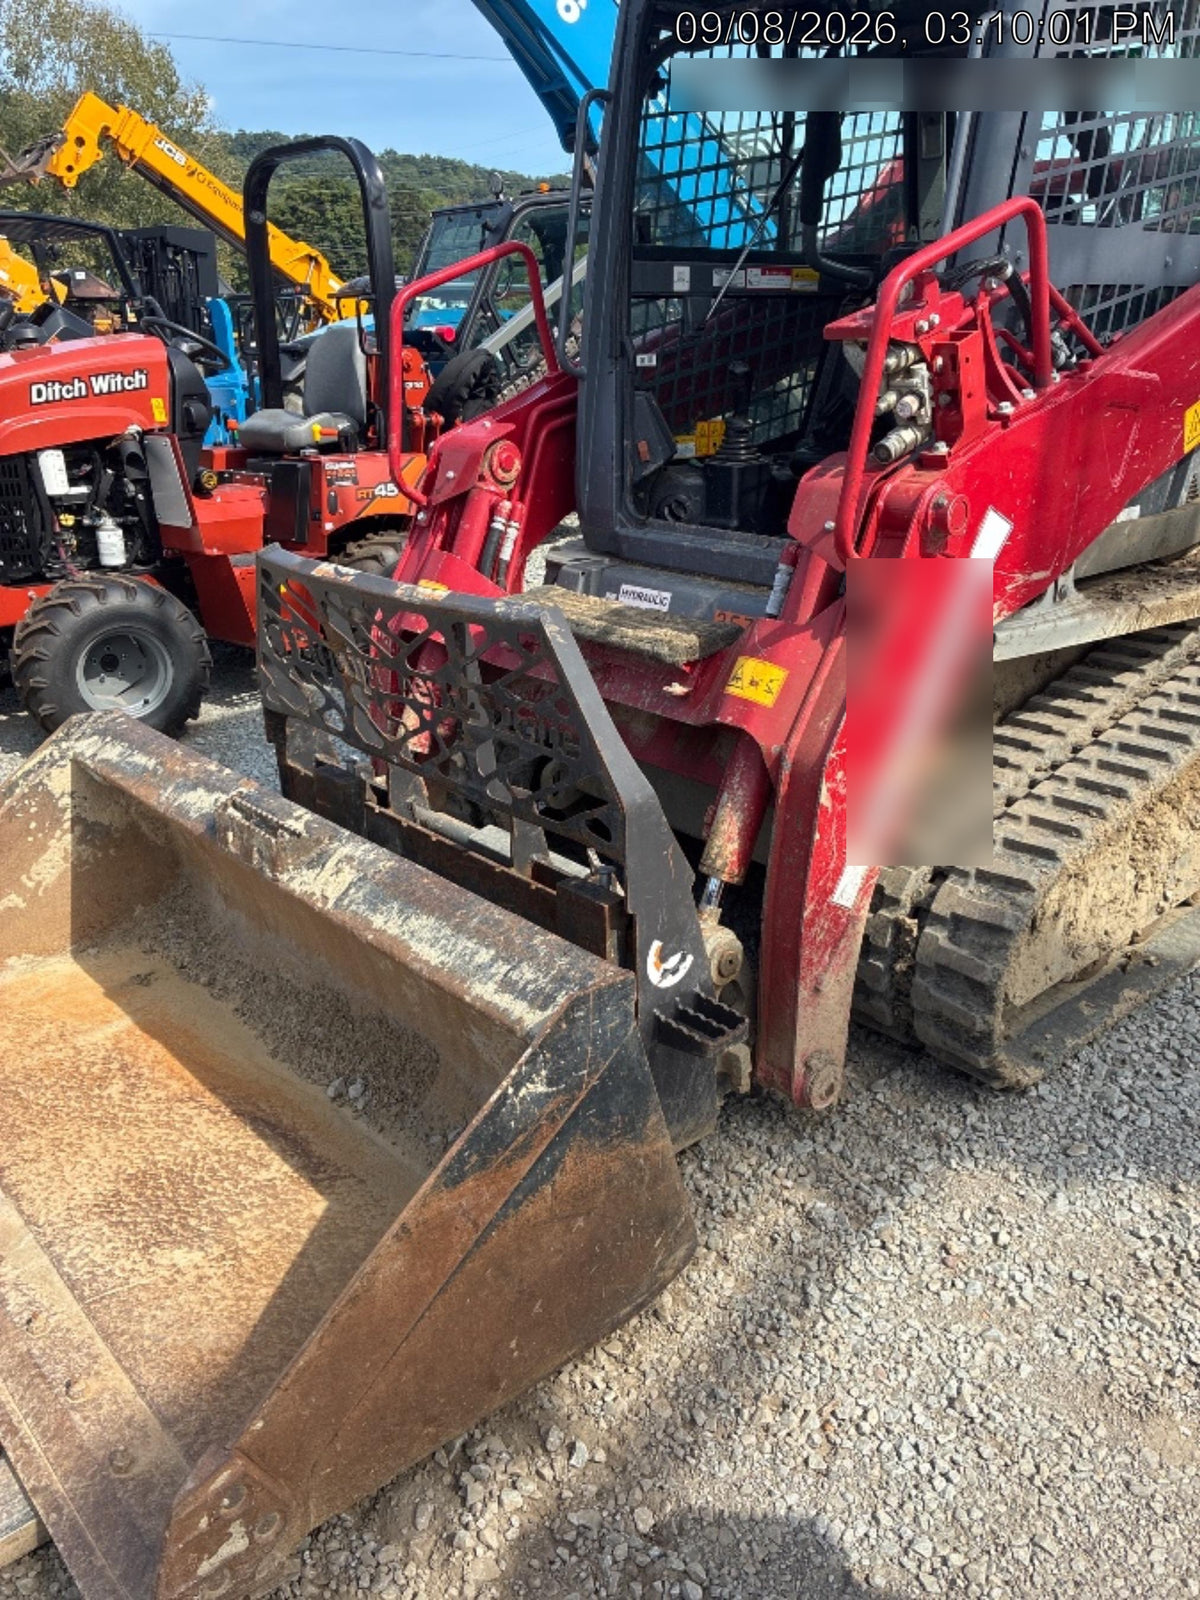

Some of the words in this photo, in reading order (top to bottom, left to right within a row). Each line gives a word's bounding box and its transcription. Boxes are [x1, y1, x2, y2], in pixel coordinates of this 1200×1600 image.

[153, 138, 187, 167] JCB
[30, 377, 88, 406] Ditch
[88, 369, 148, 395] Witch
